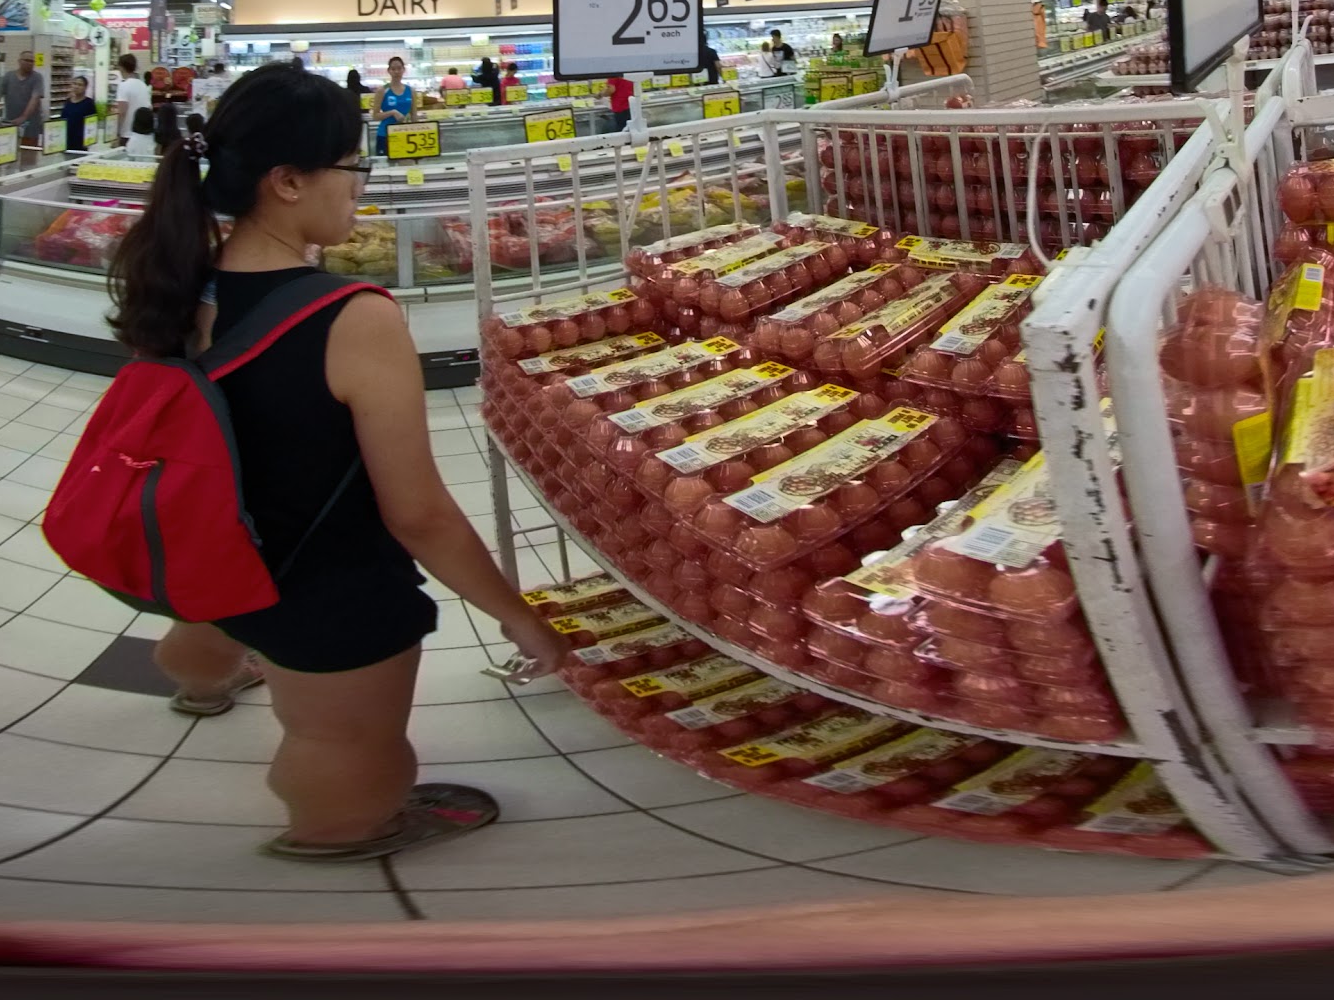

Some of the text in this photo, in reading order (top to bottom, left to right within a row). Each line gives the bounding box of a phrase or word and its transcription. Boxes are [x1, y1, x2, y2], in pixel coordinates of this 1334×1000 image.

[661, 30, 681, 38] each
[545, 118, 573, 140] 6.75
[406, 131, 436, 154] 5.35
